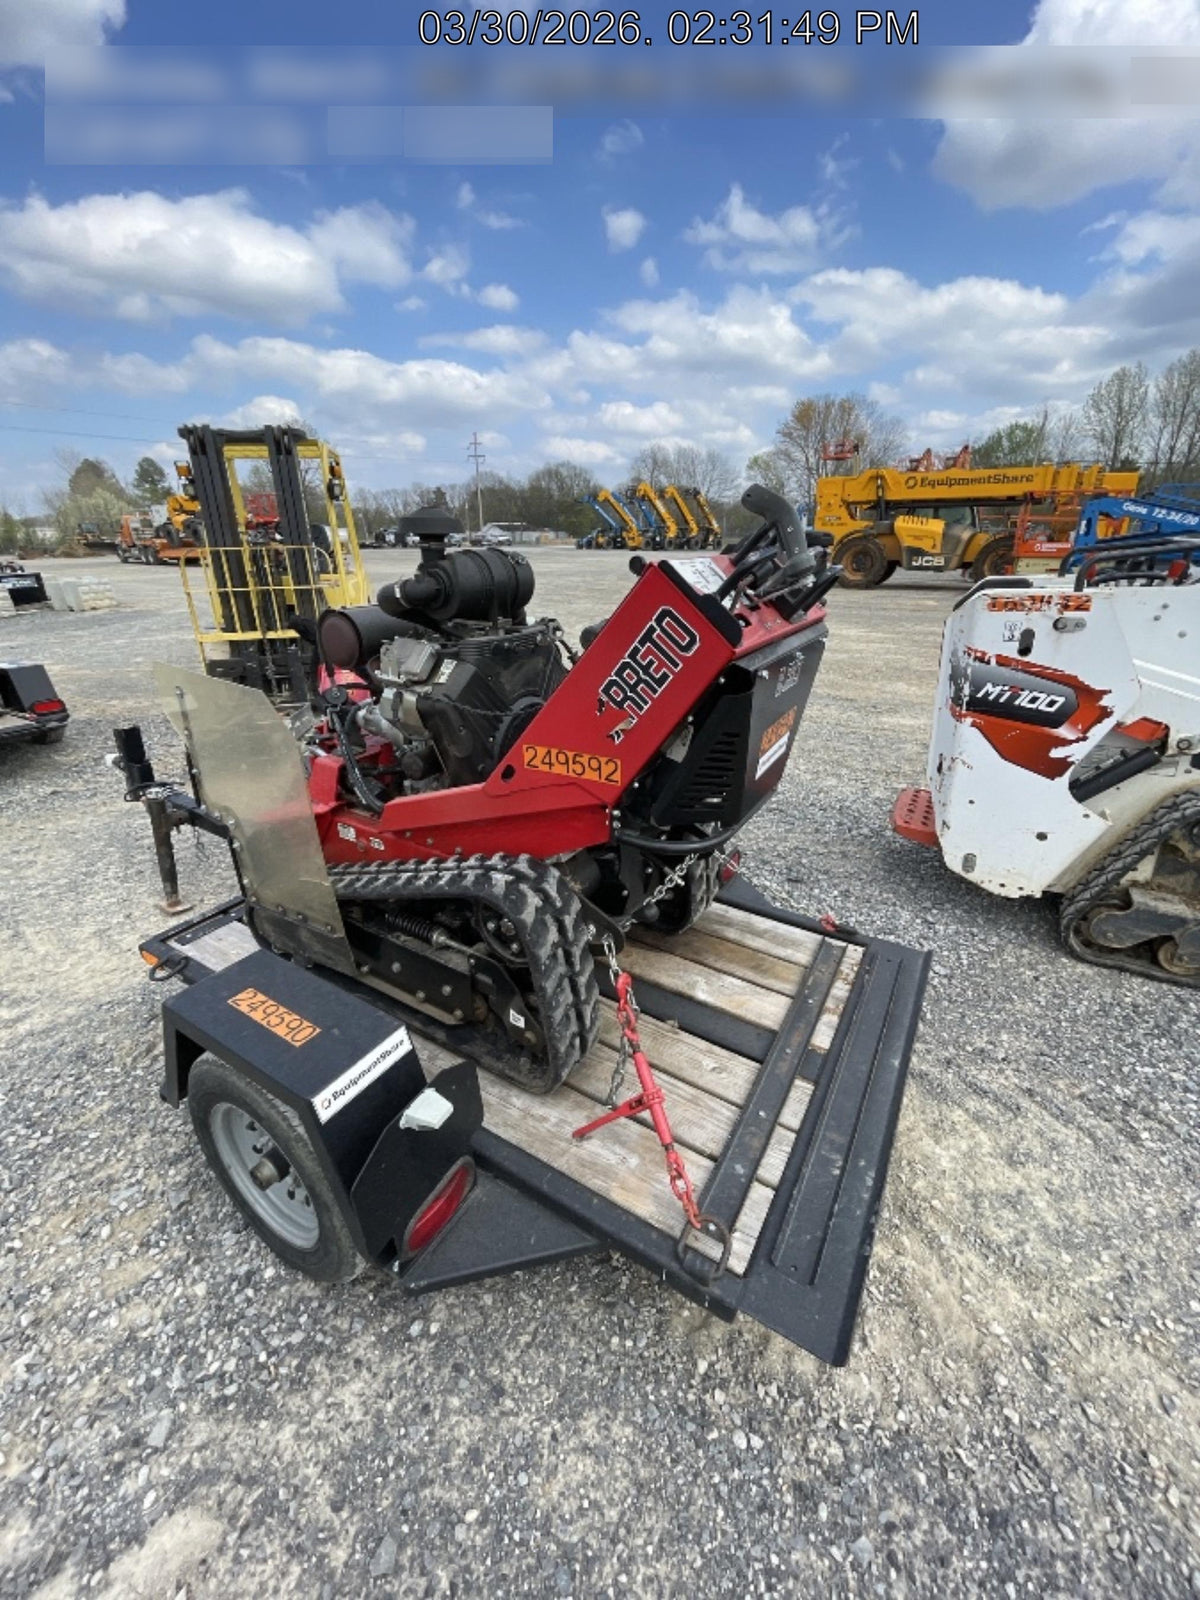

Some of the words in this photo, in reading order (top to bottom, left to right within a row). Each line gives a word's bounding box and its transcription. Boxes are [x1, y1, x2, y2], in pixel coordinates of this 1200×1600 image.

[919, 473, 1034, 489] EquipmentShare
[911, 556, 945, 567] JCB
[976, 682, 1066, 713] MT100
[525, 745, 620, 784] 249592
[233, 990, 317, 1043] 249590
[331, 1037, 405, 1102] EquipmentShare
